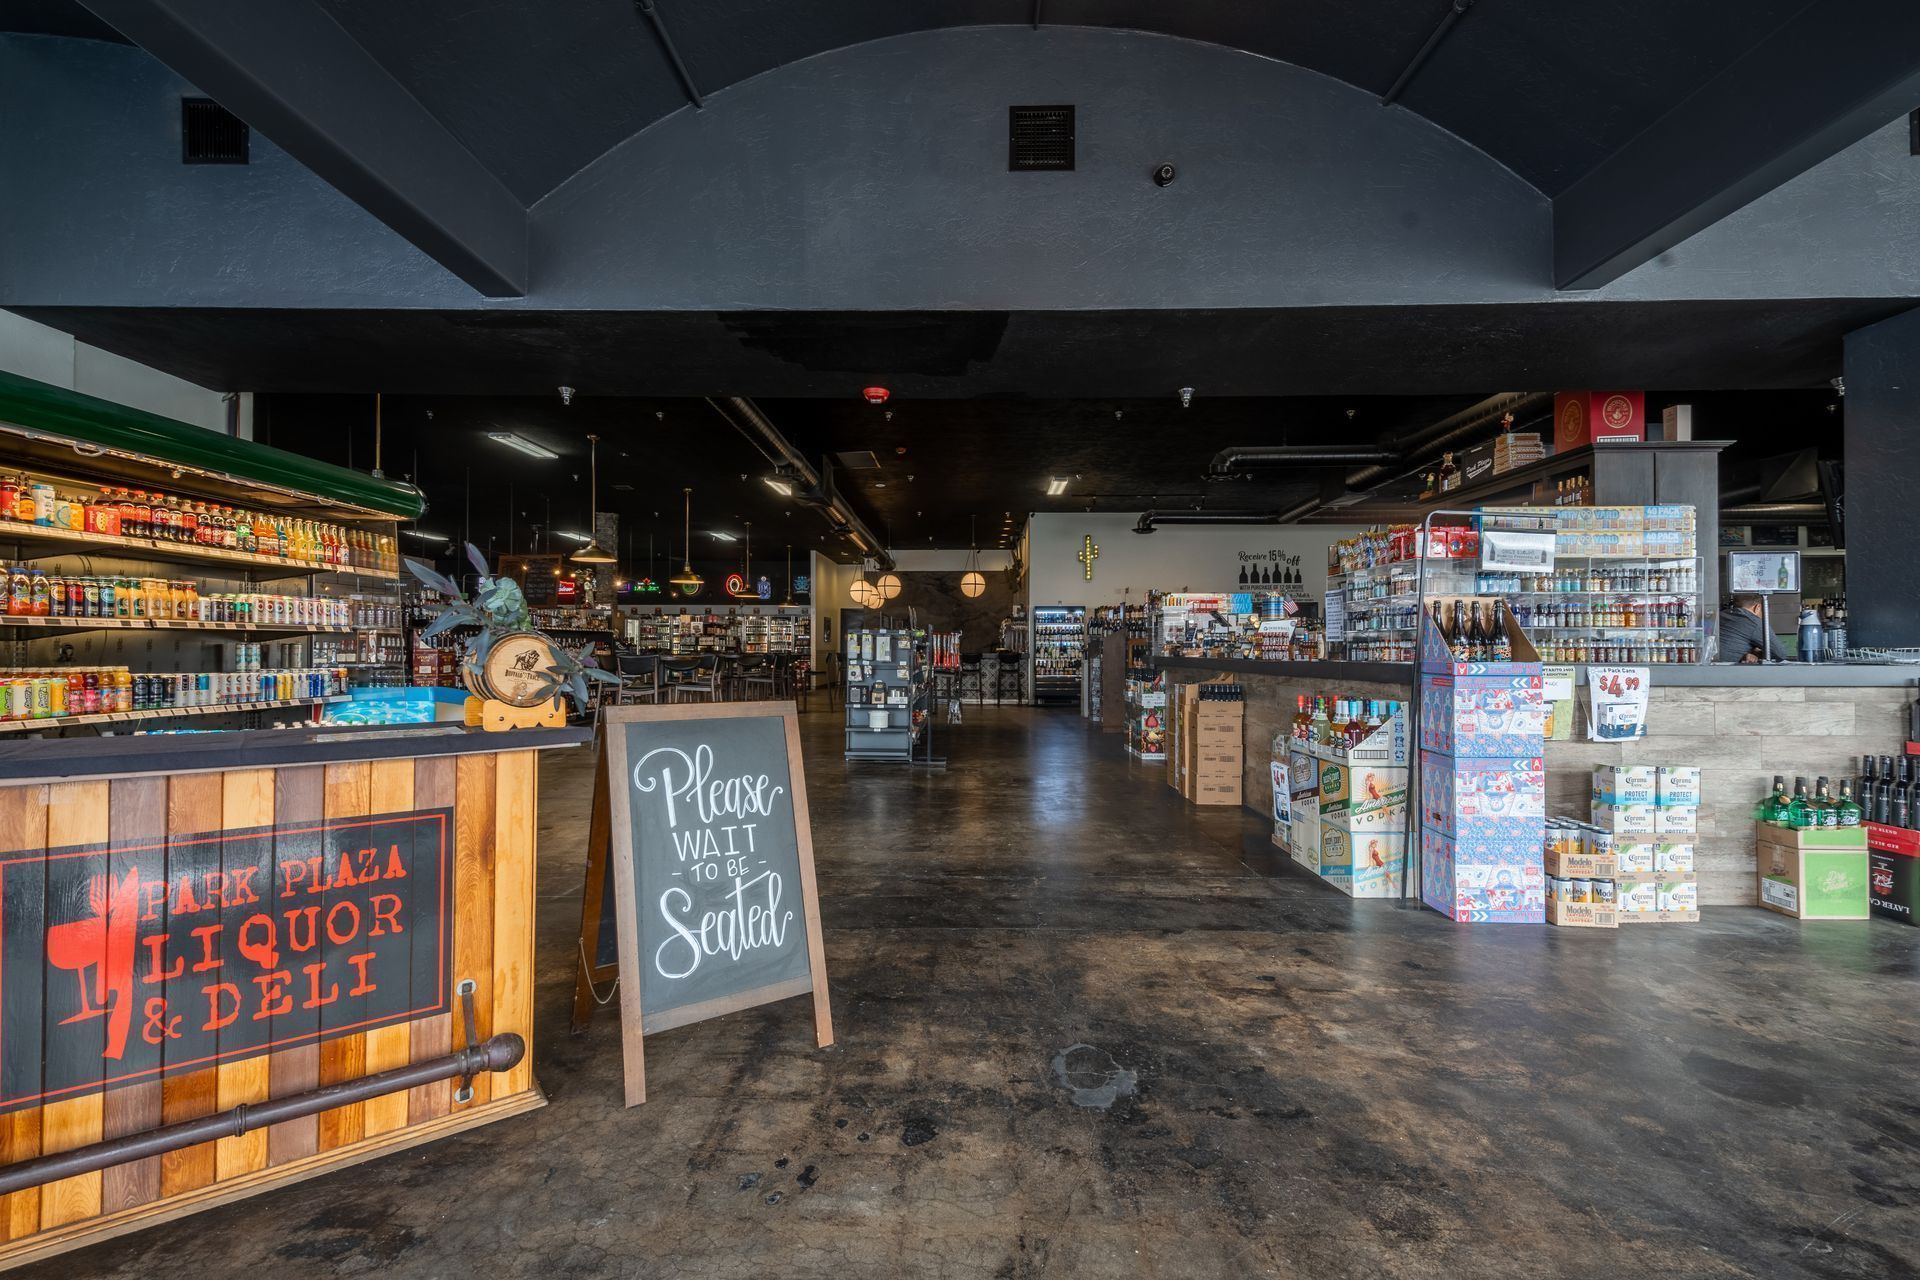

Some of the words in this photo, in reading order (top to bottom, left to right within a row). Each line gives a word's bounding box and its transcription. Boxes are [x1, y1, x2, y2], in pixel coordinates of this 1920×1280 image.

[1594, 509, 1619, 519] YARD
[1659, 507, 1680, 515] PACK
[1593, 534, 1619, 544] YARD
[1238, 550, 1267, 562] Receive
[1268, 550, 1286, 562] 15%
[1286, 555, 1301, 566] off
[504, 669, 523, 678] BUFFALO
[634, 743, 784, 828] Please
[1378, 782, 1407, 793] AUTHENTIC
[1302, 798, 1316, 806] VODKA
[1331, 812, 1347, 820] VODKA
[1356, 806, 1407, 825] VODKA
[672, 824, 758, 862] WAIT
[1568, 856, 1592, 866] Modelo
[1628, 854, 1650, 862] Corona
[1669, 854, 1691, 862] Corona
[690, 862, 719, 882] TO
[727, 856, 750, 877] BE
[141, 865, 260, 922] PARK
[280, 843, 408, 899] PLAZA
[1596, 888, 1612, 898] Mode
[1870, 897, 1882, 907] CA
[1566, 904, 1592, 914] Modelo
[1884, 901, 1910, 914] LAYER
[655, 870, 793, 979] Seated
[141, 894, 405, 985] LIQUOR
[141, 996, 183, 1045] &
[201, 952, 378, 1032] DELI
